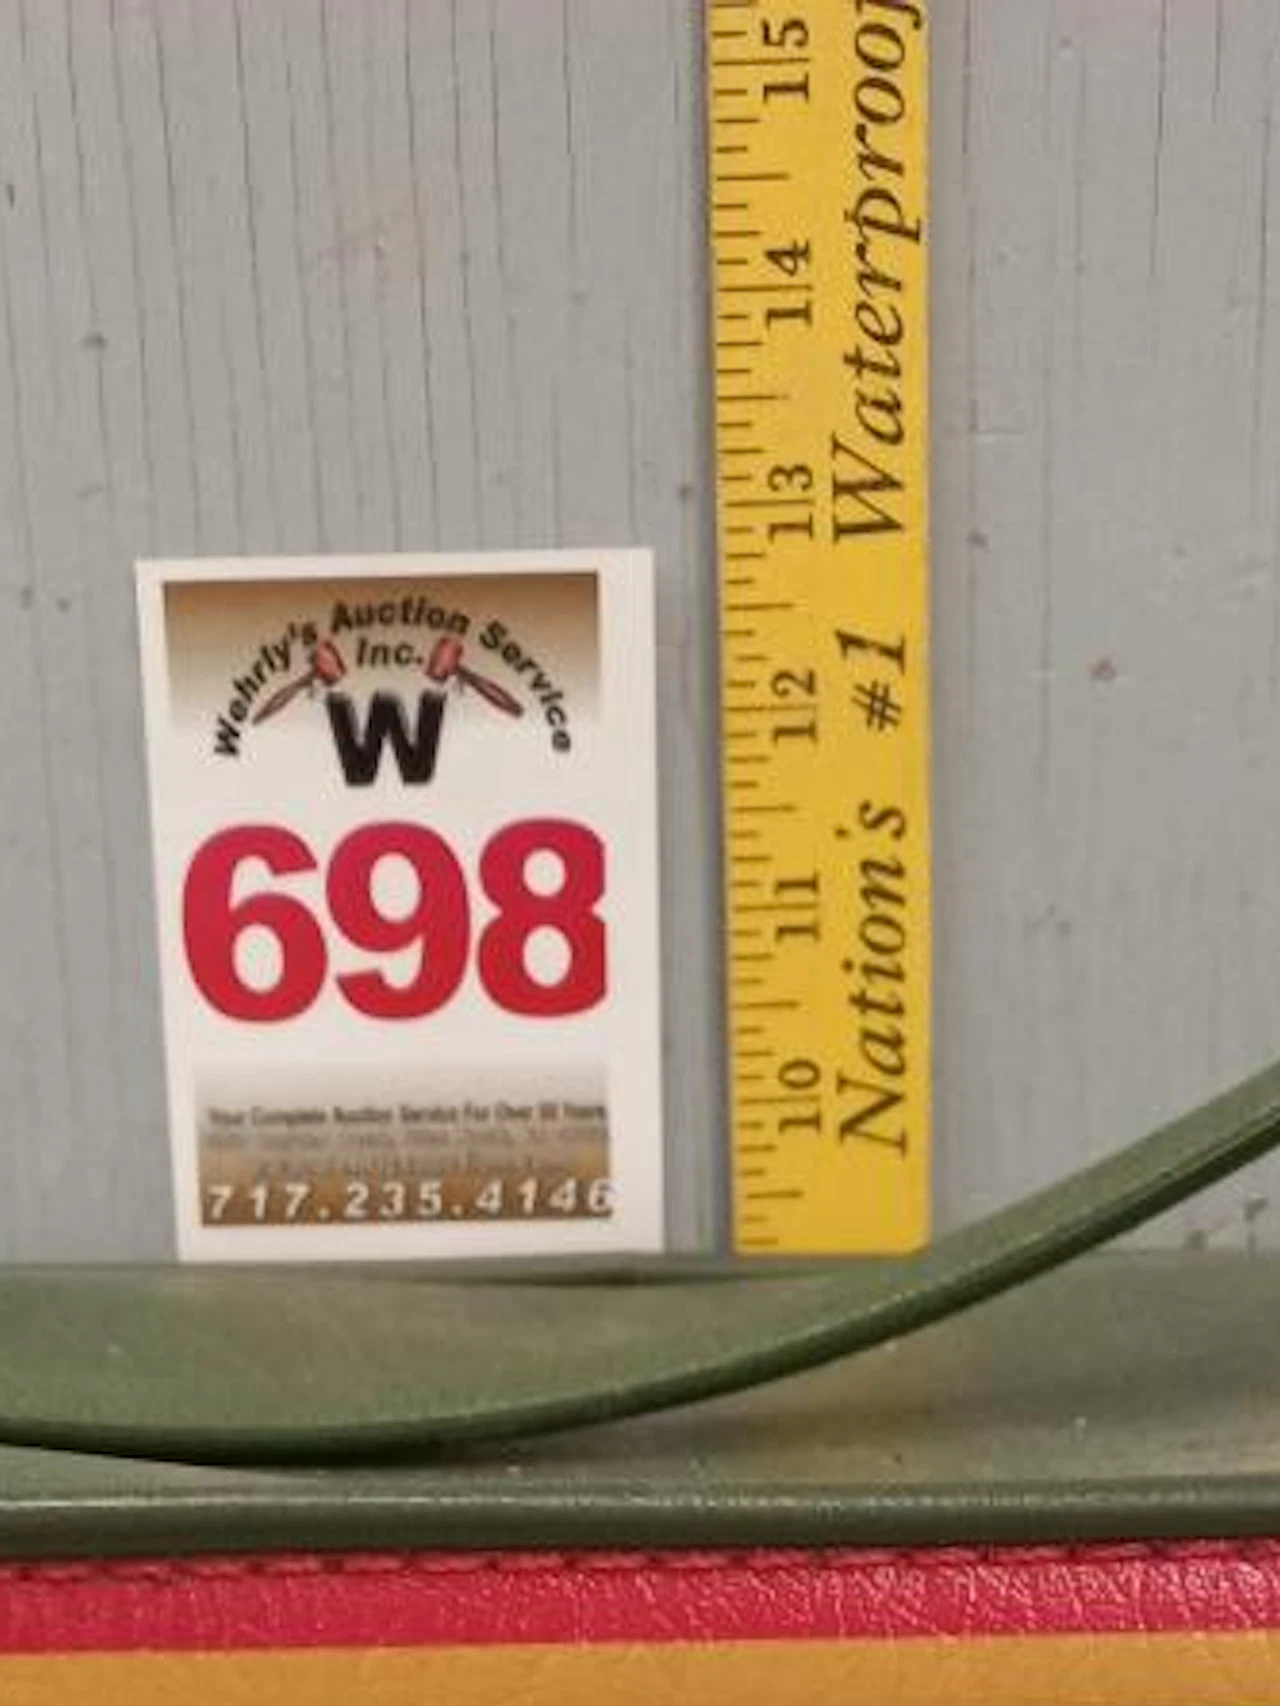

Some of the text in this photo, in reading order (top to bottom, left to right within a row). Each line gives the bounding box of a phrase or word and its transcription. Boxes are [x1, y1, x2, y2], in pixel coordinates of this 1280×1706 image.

[763, 18, 810, 104] 15
[765, 239, 814, 329] 14
[767, 462, 815, 543] 13
[213, 597, 574, 758] Wehrly's Auction Service
[354, 637, 424, 668] Inc.
[324, 687, 449, 788] W
[771, 667, 818, 745] 12
[181, 817, 608, 1024] 698
[774, 872, 821, 942] 11
[834, 799, 909, 1158] Nation's
[777, 1058, 822, 1136] 10
